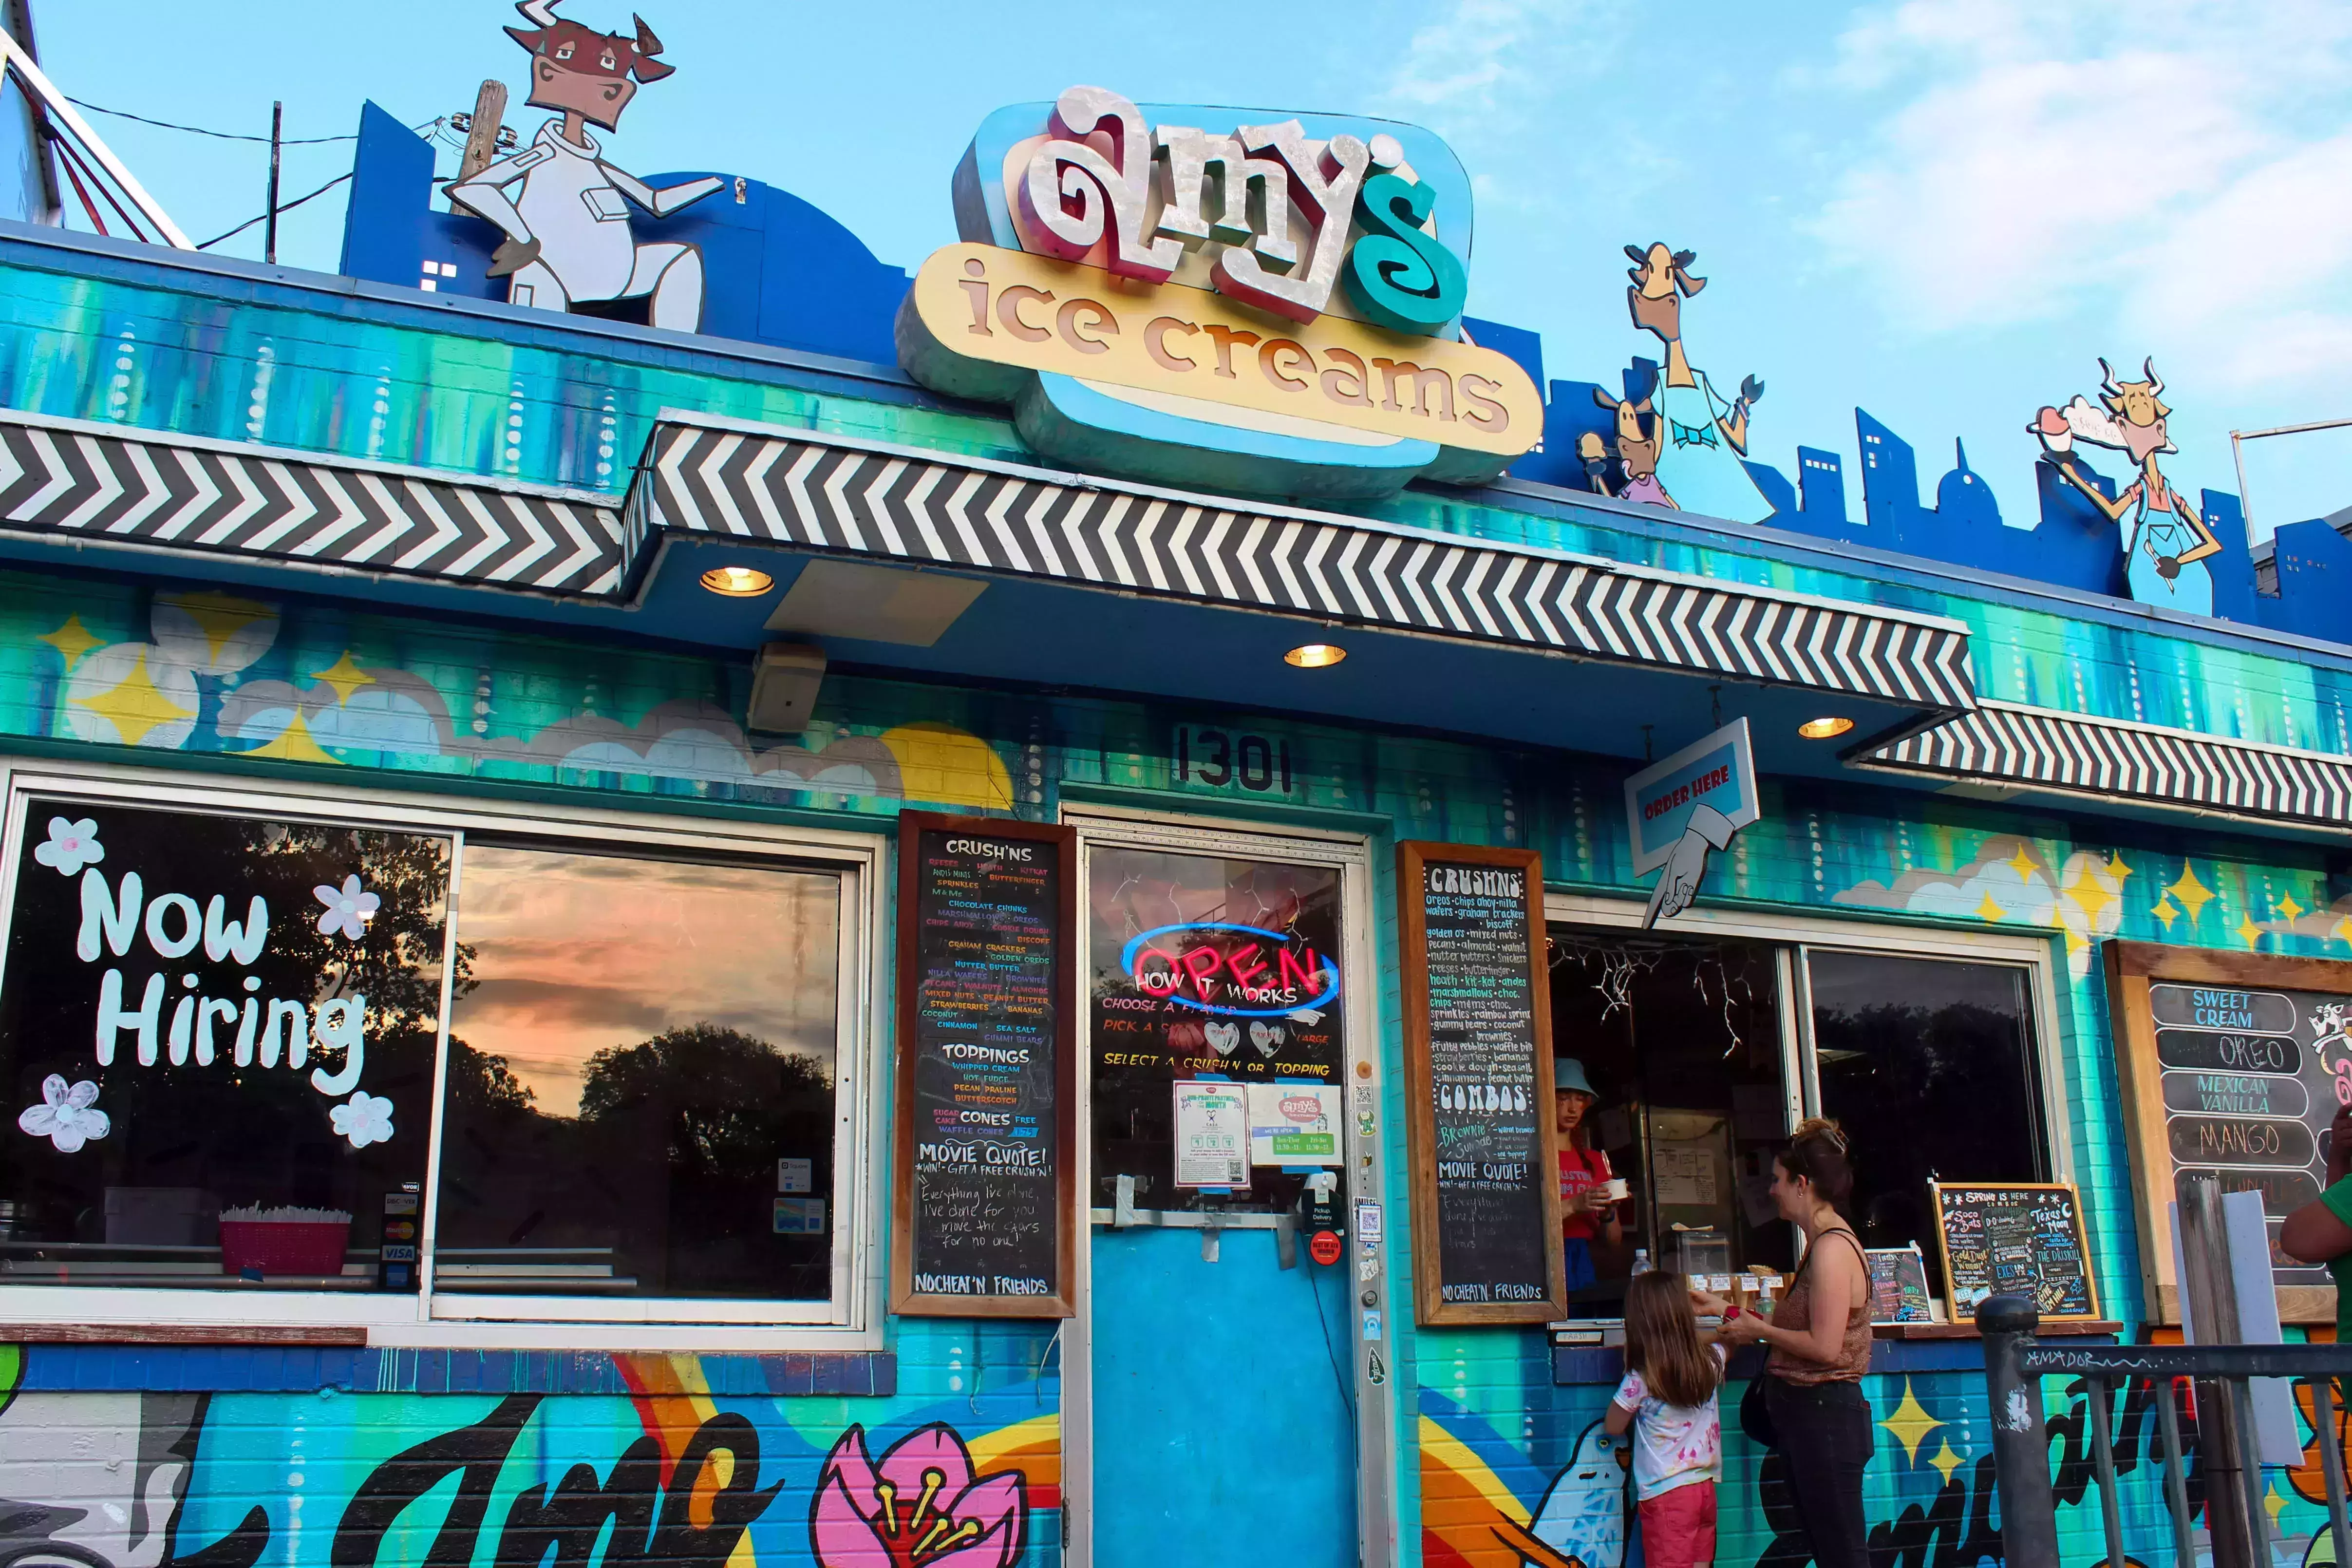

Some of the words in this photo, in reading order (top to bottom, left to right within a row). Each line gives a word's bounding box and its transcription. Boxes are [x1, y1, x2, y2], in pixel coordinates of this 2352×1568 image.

[959, 258, 1119, 354] ice
[1144, 316, 1509, 433] creams
[1179, 727, 1291, 793] 1301
[1644, 785, 1690, 820] ORDER
[1692, 764, 1730, 797] HERE
[946, 840, 1032, 861] CRUSH'NS
[937, 880, 979, 888] SPRINKLES
[953, 870, 971, 878] MINTS
[989, 874, 1046, 886] BUTTERFINGER
[1431, 868, 1520, 898] CRUSH'NS
[949, 900, 993, 910] CHOCOLATE
[997, 905, 1027, 913] CHUNKS
[1455, 896, 1475, 909] chips
[1477, 898, 1496, 911] ahoy
[1499, 897, 1517, 908] nilla
[1426, 907, 1453, 916] wafers
[1458, 909, 1488, 919] graham
[1486, 919, 1513, 929] biscoff
[1427, 928, 1452, 939] golden
[1469, 930, 1496, 939] mixed
[1499, 931, 1517, 939] nuts
[948, 941, 981, 949] GRAHAM
[986, 944, 1026, 953] CRACKERS
[1017, 936, 1051, 945] BISCOFF
[1462, 941, 1495, 950] almonds
[1430, 952, 1459, 961] nutter
[1461, 952, 1489, 962] butters
[955, 961, 987, 970] NUTTER
[989, 963, 1020, 972] BUTTER
[1134, 943, 1319, 1001] OPEN
[1431, 964, 1459, 973] reeses
[1464, 964, 1510, 977] butterfinger
[928, 969, 949, 978] NILLA
[955, 971, 987, 980] WAFERS
[1006, 975, 1046, 983] BROWNIES
[1430, 974, 1457, 985] heath
[1465, 975, 1496, 987] kit-kat
[1502, 977, 1526, 986] andes
[925, 980, 957, 988] PECANS
[964, 982, 1001, 991] WALNUTS
[1135, 972, 1185, 991] HOW
[1197, 977, 1215, 994] IT
[1226, 983, 1298, 1004] WORKS
[1433, 988, 1492, 998] marshmallows
[2193, 990, 2251, 1009] SWEET
[930, 1001, 989, 1010] STRAWBERRIES
[1018, 996, 1050, 1004] BUTTER
[1103, 998, 1157, 1011] CHOOSE
[1163, 1002, 1176, 1013] A
[1430, 999, 1451, 1011] chips
[1430, 1009, 1469, 1020] sprinkles
[1474, 1009, 1506, 1020] rainbow
[2195, 1008, 2252, 1028] CREAM
[937, 1021, 978, 1029] CINNAMON
[1103, 1020, 1137, 1032] PICK
[1143, 1023, 1153, 1033] A
[1434, 1020, 1464, 1031] gummy
[1466, 1020, 1487, 1029] bears
[1494, 1020, 1525, 1028] coconut
[96, 969, 365, 1096] Hiring
[1477, 1030, 1512, 1040] brownies
[1017, 1036, 1042, 1044] BEARS
[942, 1043, 1030, 1063] TOPPINGS
[2220, 1036, 2284, 1069] OREO
[952, 1062, 988, 1071] WHIPPED
[992, 1064, 1020, 1073] CREAM
[1104, 1052, 1159, 1065] SELECT
[1248, 1062, 1265, 1073] OR
[1275, 1063, 1330, 1076] TOPPING
[985, 1085, 1017, 1094] PRALINE
[2198, 1075, 2269, 1095] MEXICAN
[955, 1095, 1016, 1104] BUTTERSCOTCH
[1441, 1084, 1526, 1111] COMBOS
[2201, 1094, 2269, 1113] VANILLA
[960, 1111, 1011, 1125] CONES
[2200, 1122, 2278, 1154] MANGO
[919, 1143, 977, 1163] MOVIE
[986, 1146, 1046, 1166] QUOTE!
[971, 1165, 976, 1173] A
[980, 1166, 1003, 1175] FREE
[1439, 1162, 1476, 1178] MOVIE
[1483, 1163, 1527, 1181] QUOTE!
[1966, 1192, 1995, 1202] SPRING
[949, 1206, 976, 1216] done
[984, 1203, 1005, 1216] for
[2031, 1209, 2060, 1222] Texas
[941, 1221, 972, 1232] move
[977, 1220, 996, 1232] the
[1960, 1219, 1981, 1233] Bats
[2047, 1220, 2069, 1233] Moon
[942, 1236, 962, 1248] for
[973, 1236, 985, 1246] no
[386, 1248, 412, 1258] VISA
[2036, 1250, 2050, 1262] THE
[2051, 1251, 2081, 1262] DRISKILL
[1997, 1266, 2014, 1278] EXES
[994, 1276, 1048, 1294] FRIENDS
[1495, 1283, 1542, 1299] FRIENDS
[2027, 1350, 2095, 1367] AMADOR
